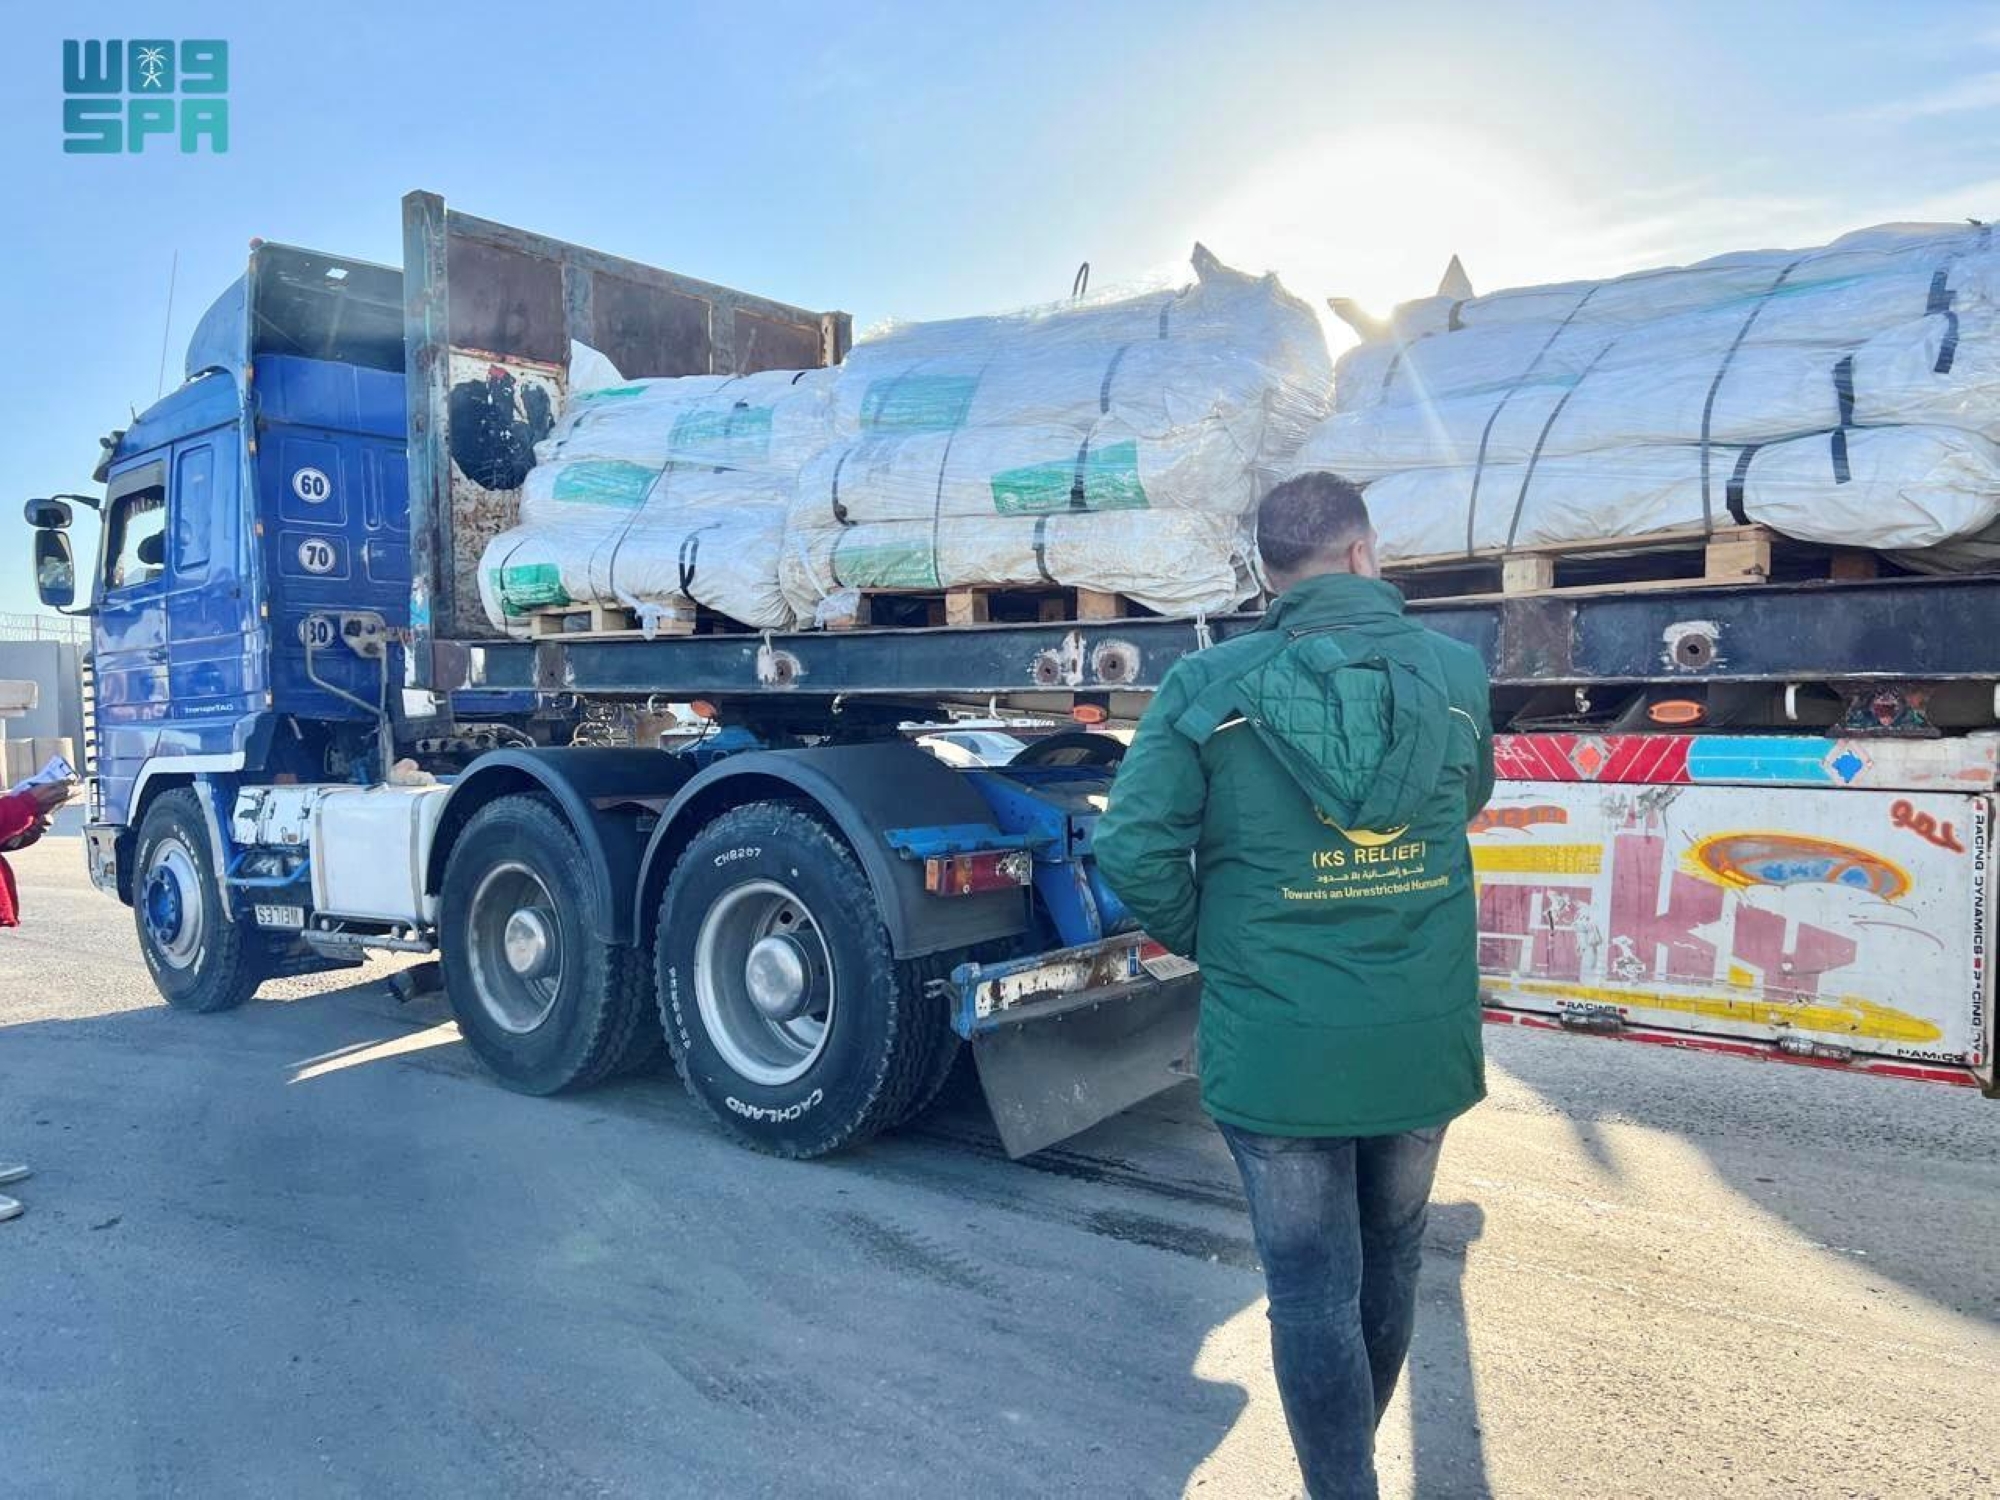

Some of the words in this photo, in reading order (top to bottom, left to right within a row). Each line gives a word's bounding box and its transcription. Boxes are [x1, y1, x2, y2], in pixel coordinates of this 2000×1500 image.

[301, 474, 325, 496] 60
[306, 545, 329, 567] 70
[1281, 887, 1328, 900] Towards
[1329, 889, 1344, 898] an
[1343, 880, 1411, 898] Unrestricted
[725, 1088, 824, 1123] CACHLAND
